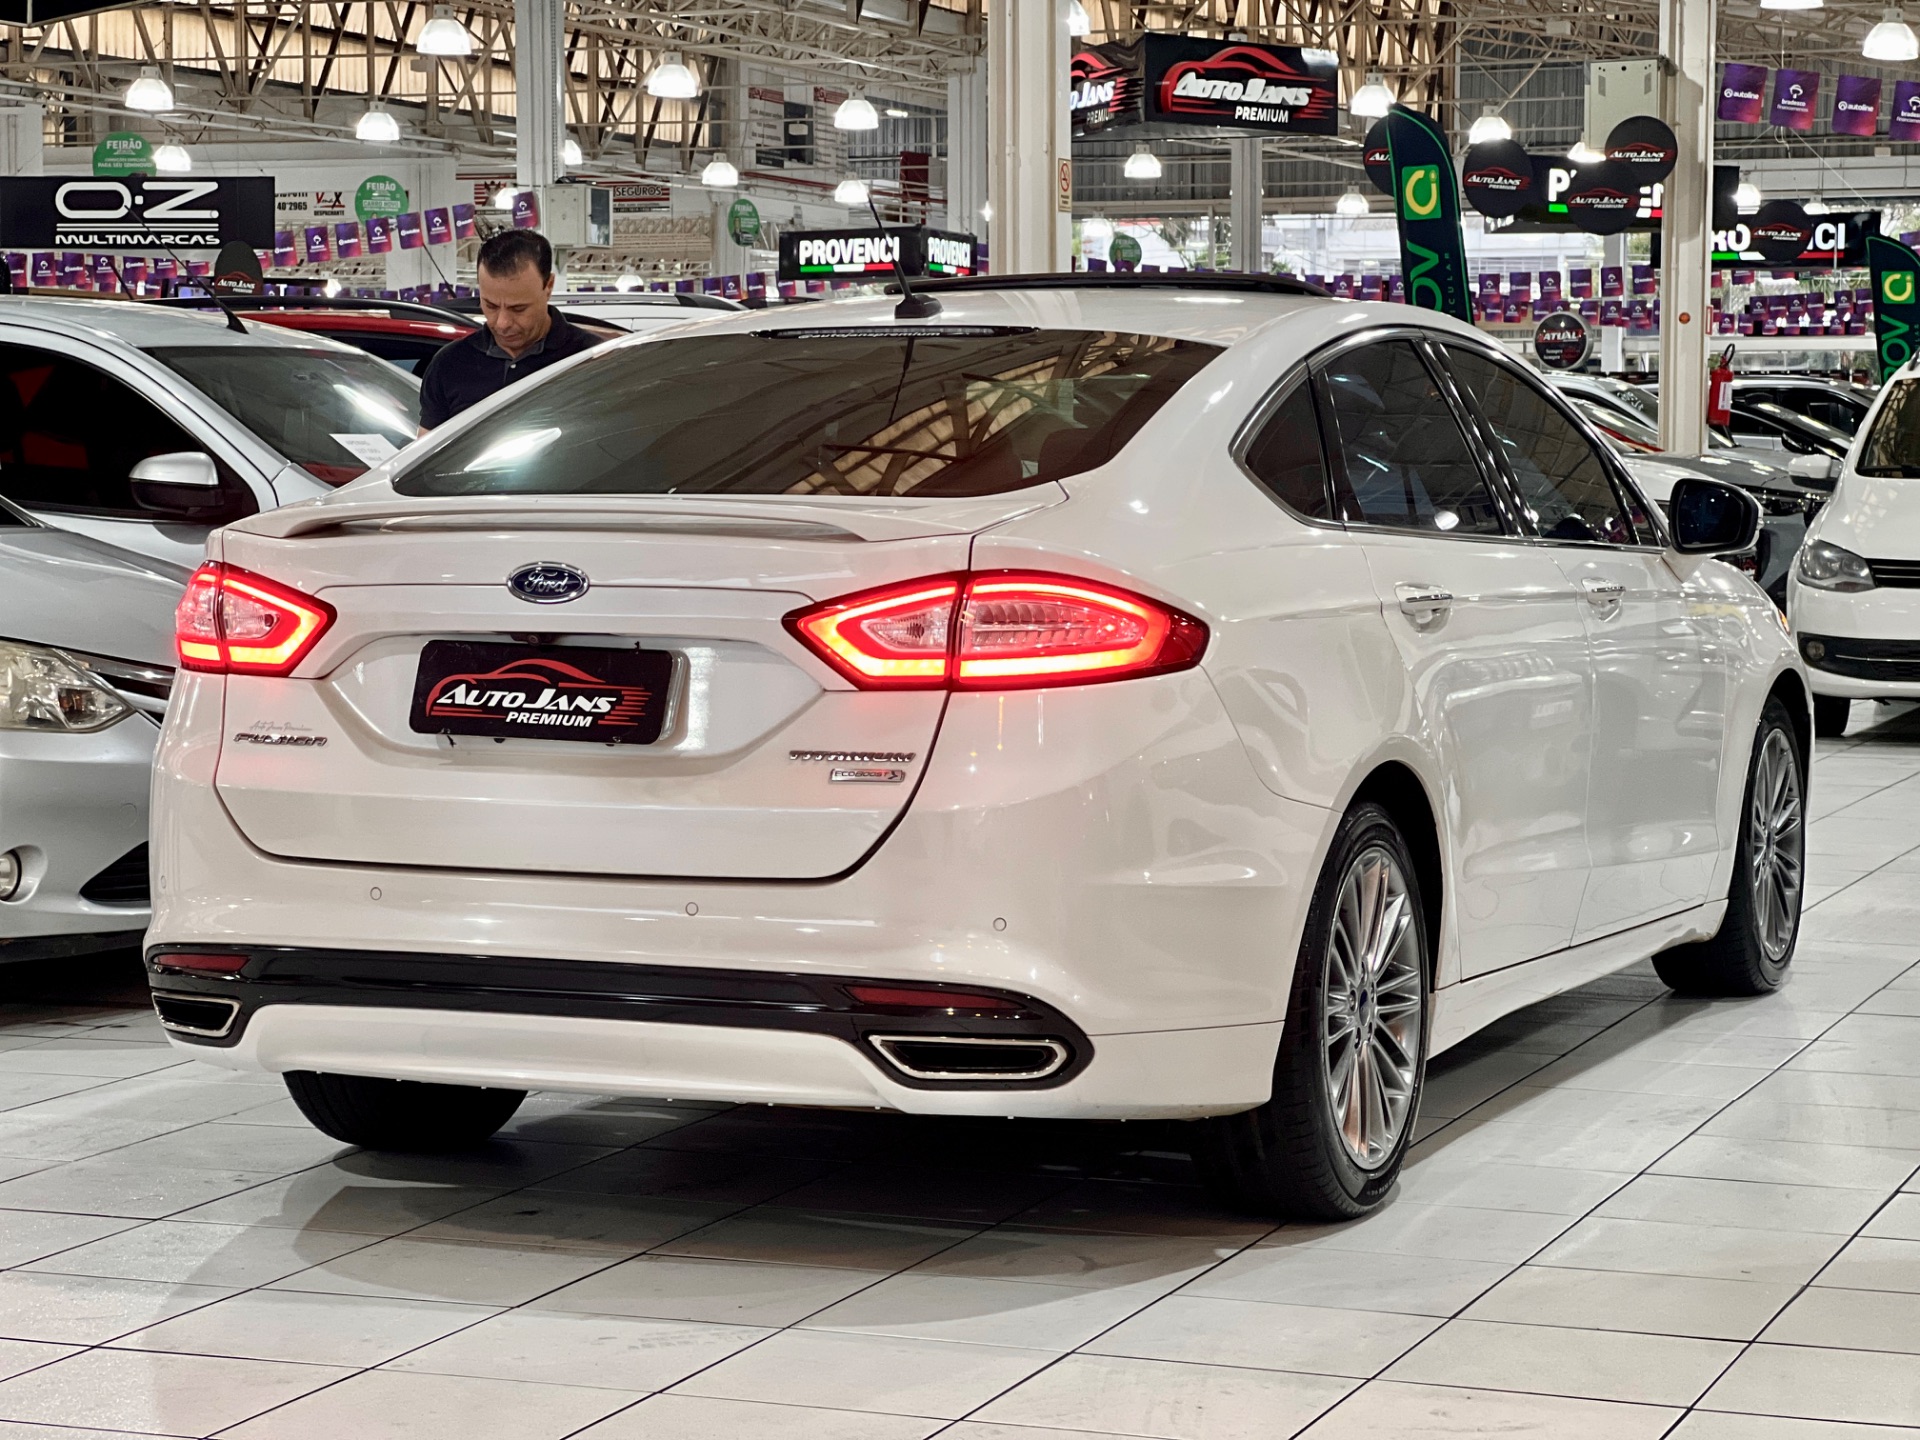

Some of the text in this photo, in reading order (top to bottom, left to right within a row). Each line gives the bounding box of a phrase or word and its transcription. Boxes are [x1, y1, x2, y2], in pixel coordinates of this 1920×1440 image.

[1733, 91, 1759, 100] autoline
[1846, 103, 1873, 112] autoline
[1234, 105, 1289, 124] PREMIUM
[106, 138, 142, 150] FEIRÃO
[366, 181, 396, 191] FEIRÃO
[616, 186, 662, 196] SEGUROS
[55, 235, 219, 245] MULTIMARCAS
[798, 236, 900, 266] PROVENCI
[928, 237, 971, 268] PROVENCI
[524, 569, 570, 593] Ford
[505, 712, 593, 728] PREMIUM
[789, 750, 917, 762] TITANIUM
